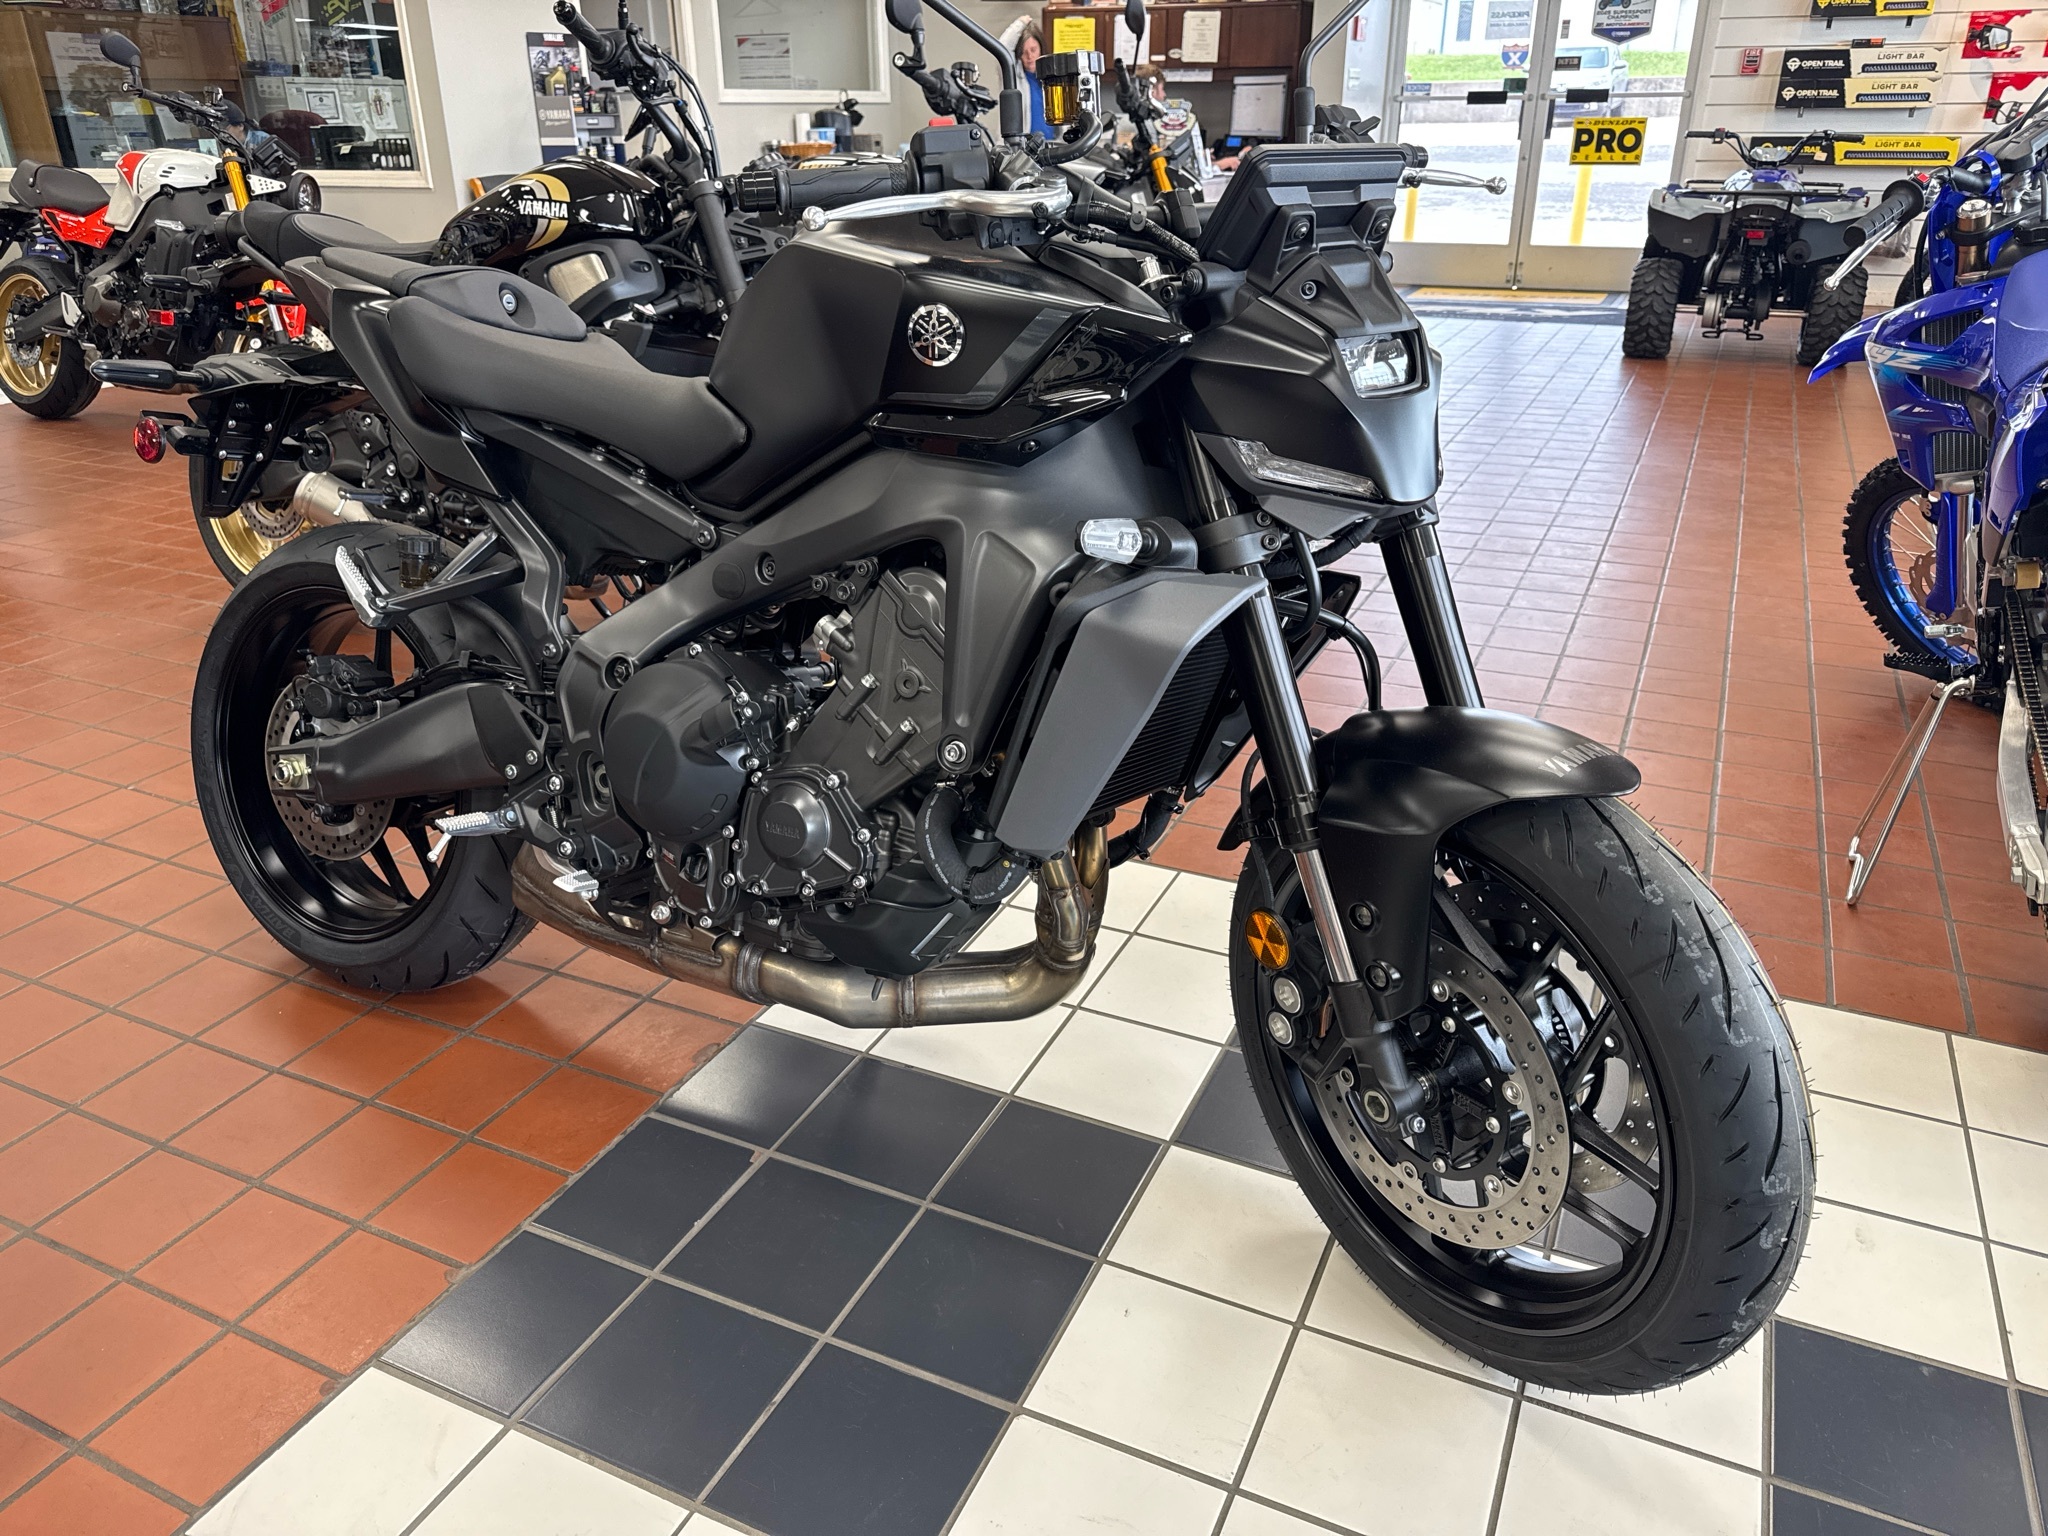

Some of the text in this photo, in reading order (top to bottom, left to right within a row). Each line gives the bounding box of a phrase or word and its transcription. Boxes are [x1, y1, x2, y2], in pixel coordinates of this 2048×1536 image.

[1824, 59, 1845, 67] TRAIL
[1796, 89, 1839, 97] OPEN TRAIL
[546, 109, 571, 119] YAMAHA
[1573, 127, 1642, 153] PRO
[518, 200, 568, 218] YAMAHA
[765, 820, 800, 839] YAMAHA
